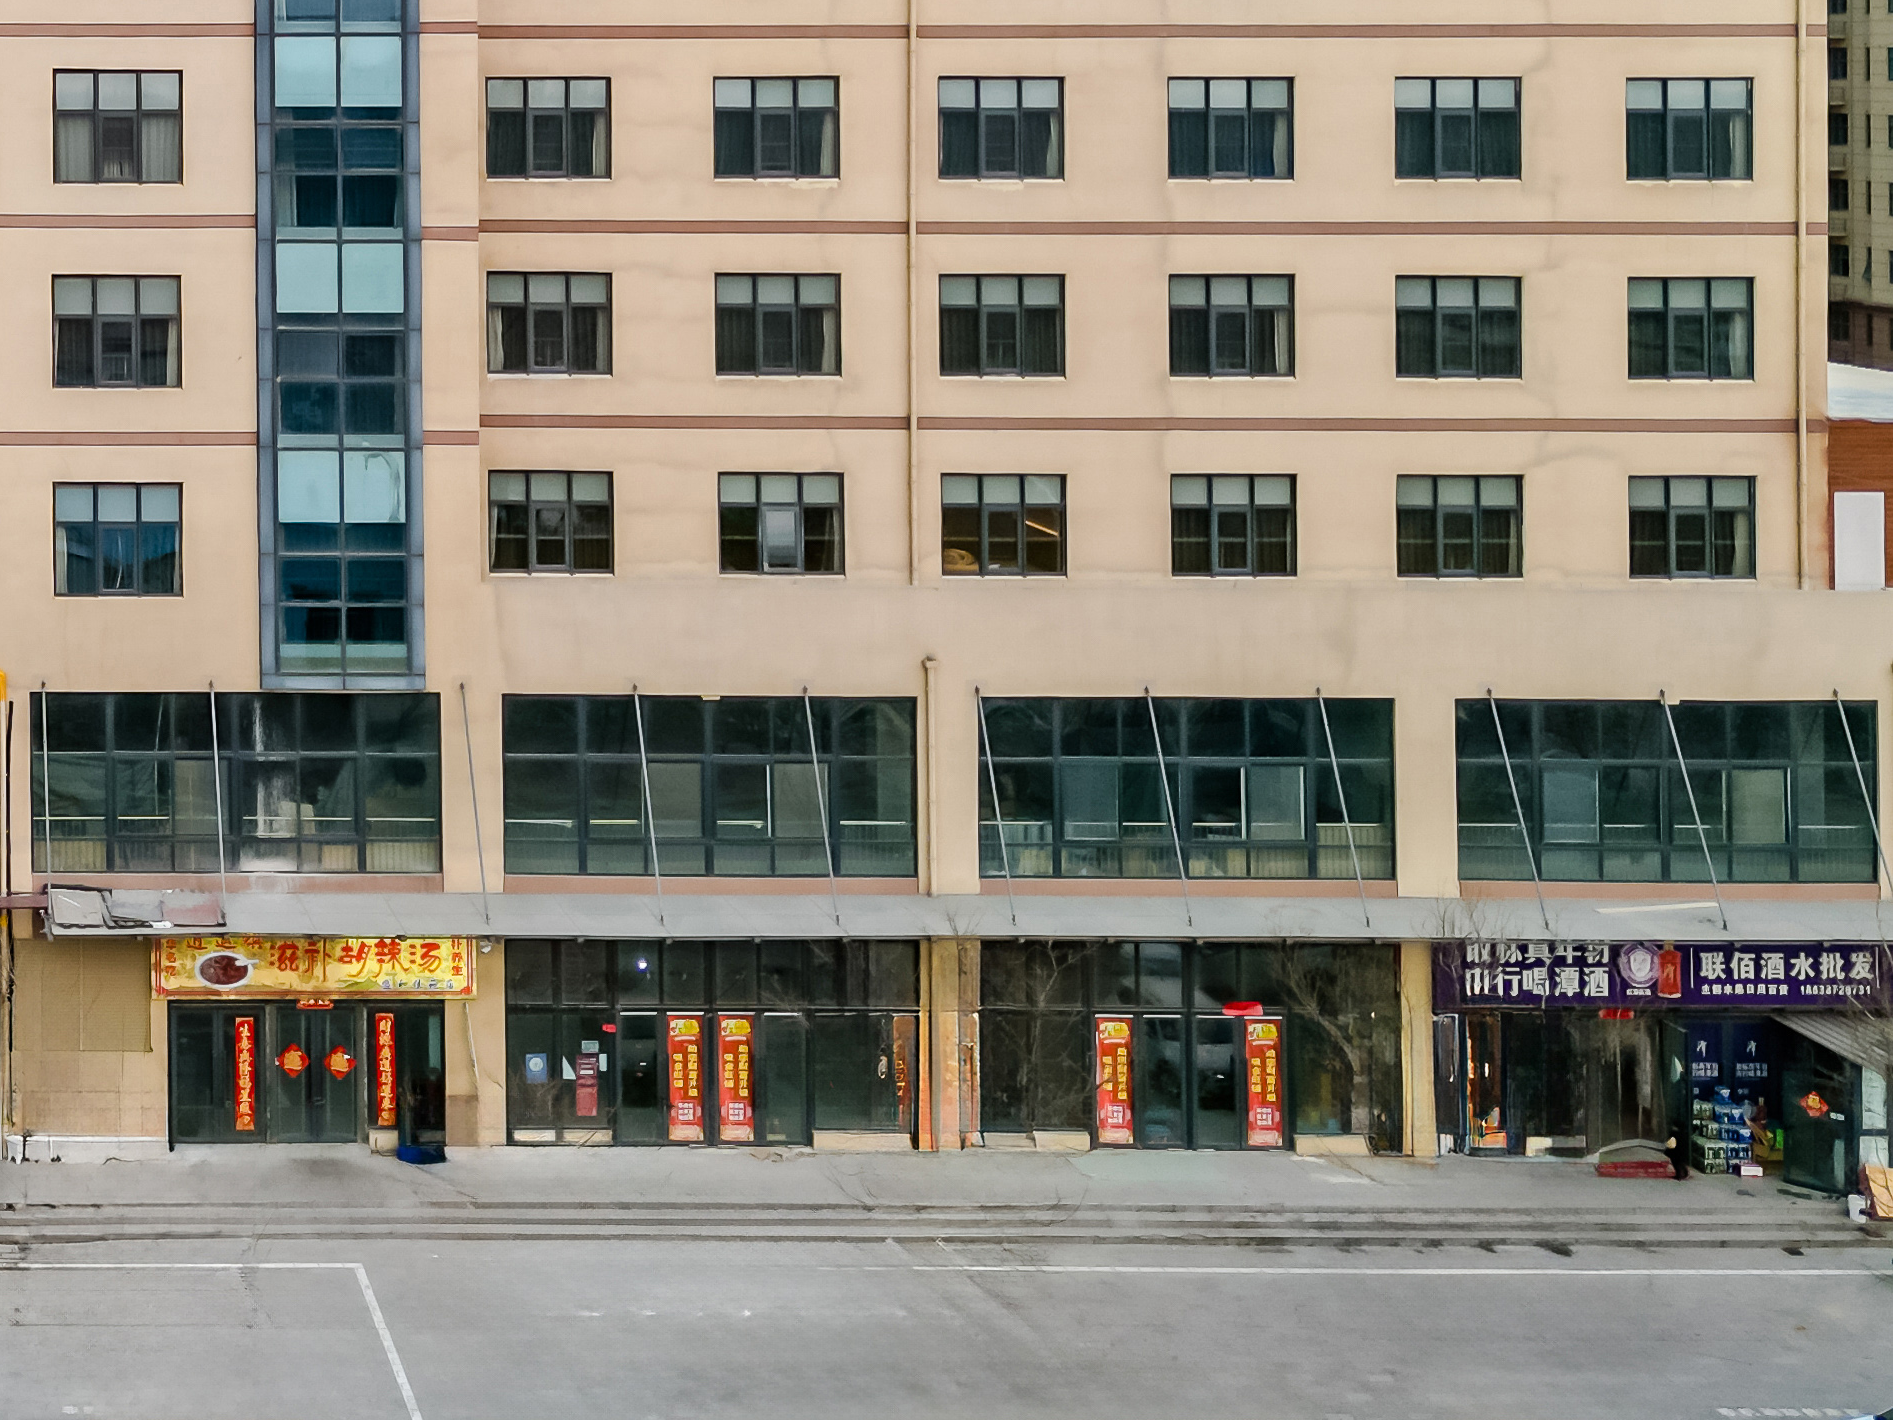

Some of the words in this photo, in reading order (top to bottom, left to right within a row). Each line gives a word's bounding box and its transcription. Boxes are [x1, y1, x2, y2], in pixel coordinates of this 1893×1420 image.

[1699, 951, 1875, 980] 联佰酒水批发
